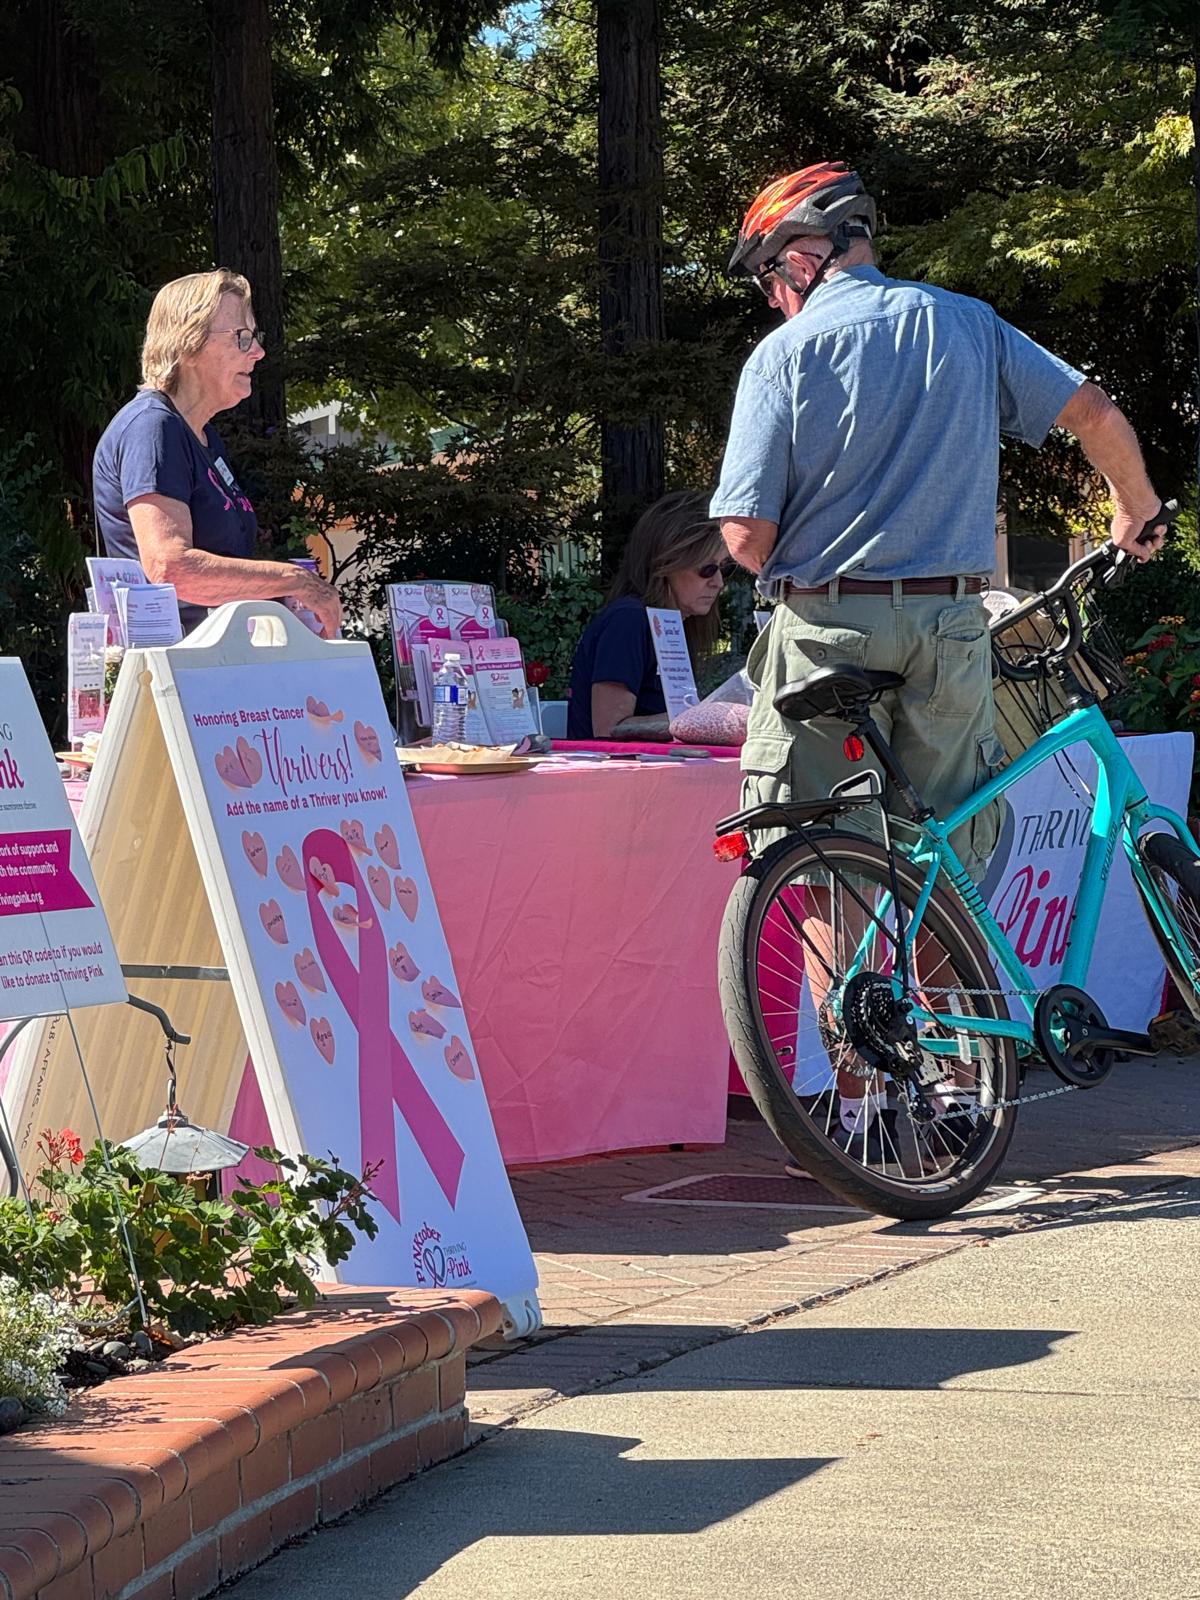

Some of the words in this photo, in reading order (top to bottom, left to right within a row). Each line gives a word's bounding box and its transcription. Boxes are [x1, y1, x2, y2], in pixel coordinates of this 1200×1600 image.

[193, 711, 240, 727] Honoring
[240, 708, 271, 723] Breast
[272, 707, 304, 720] Cancer
[253, 726, 355, 797] Thrivers!
[226, 803, 245, 817] Add
[246, 801, 261, 815] the
[263, 799, 289, 812] name
[290, 795, 300, 810] of
[302, 797, 309, 808] a
[309, 791, 341, 807] Thriver
[342, 791, 358, 807] you
[358, 786, 388, 801] know!
[1017, 807, 1091, 856] THRIVI
[11, 843, 20, 856] of
[20, 843, 46, 858] support
[45, 840, 60, 853] and
[6, 864, 20, 877] the
[19, 860, 59, 877] community.
[994, 865, 1077, 968] Pin
[8, 950, 23, 966] this
[23, 949, 35, 966] QR
[35, 947, 53, 962] code
[52, 948, 61, 960] to
[60, 944, 68, 958] if
[67, 946, 82, 962] you
[81, 940, 103, 957] would
[2, 975, 15, 990] like
[15, 975, 25, 988] to
[25, 971, 51, 987] donate
[50, 971, 60, 984] to
[58, 967, 90, 983] Thriving
[87, 963, 104, 979] Pink
[445, 1255, 472, 1281] Pink
